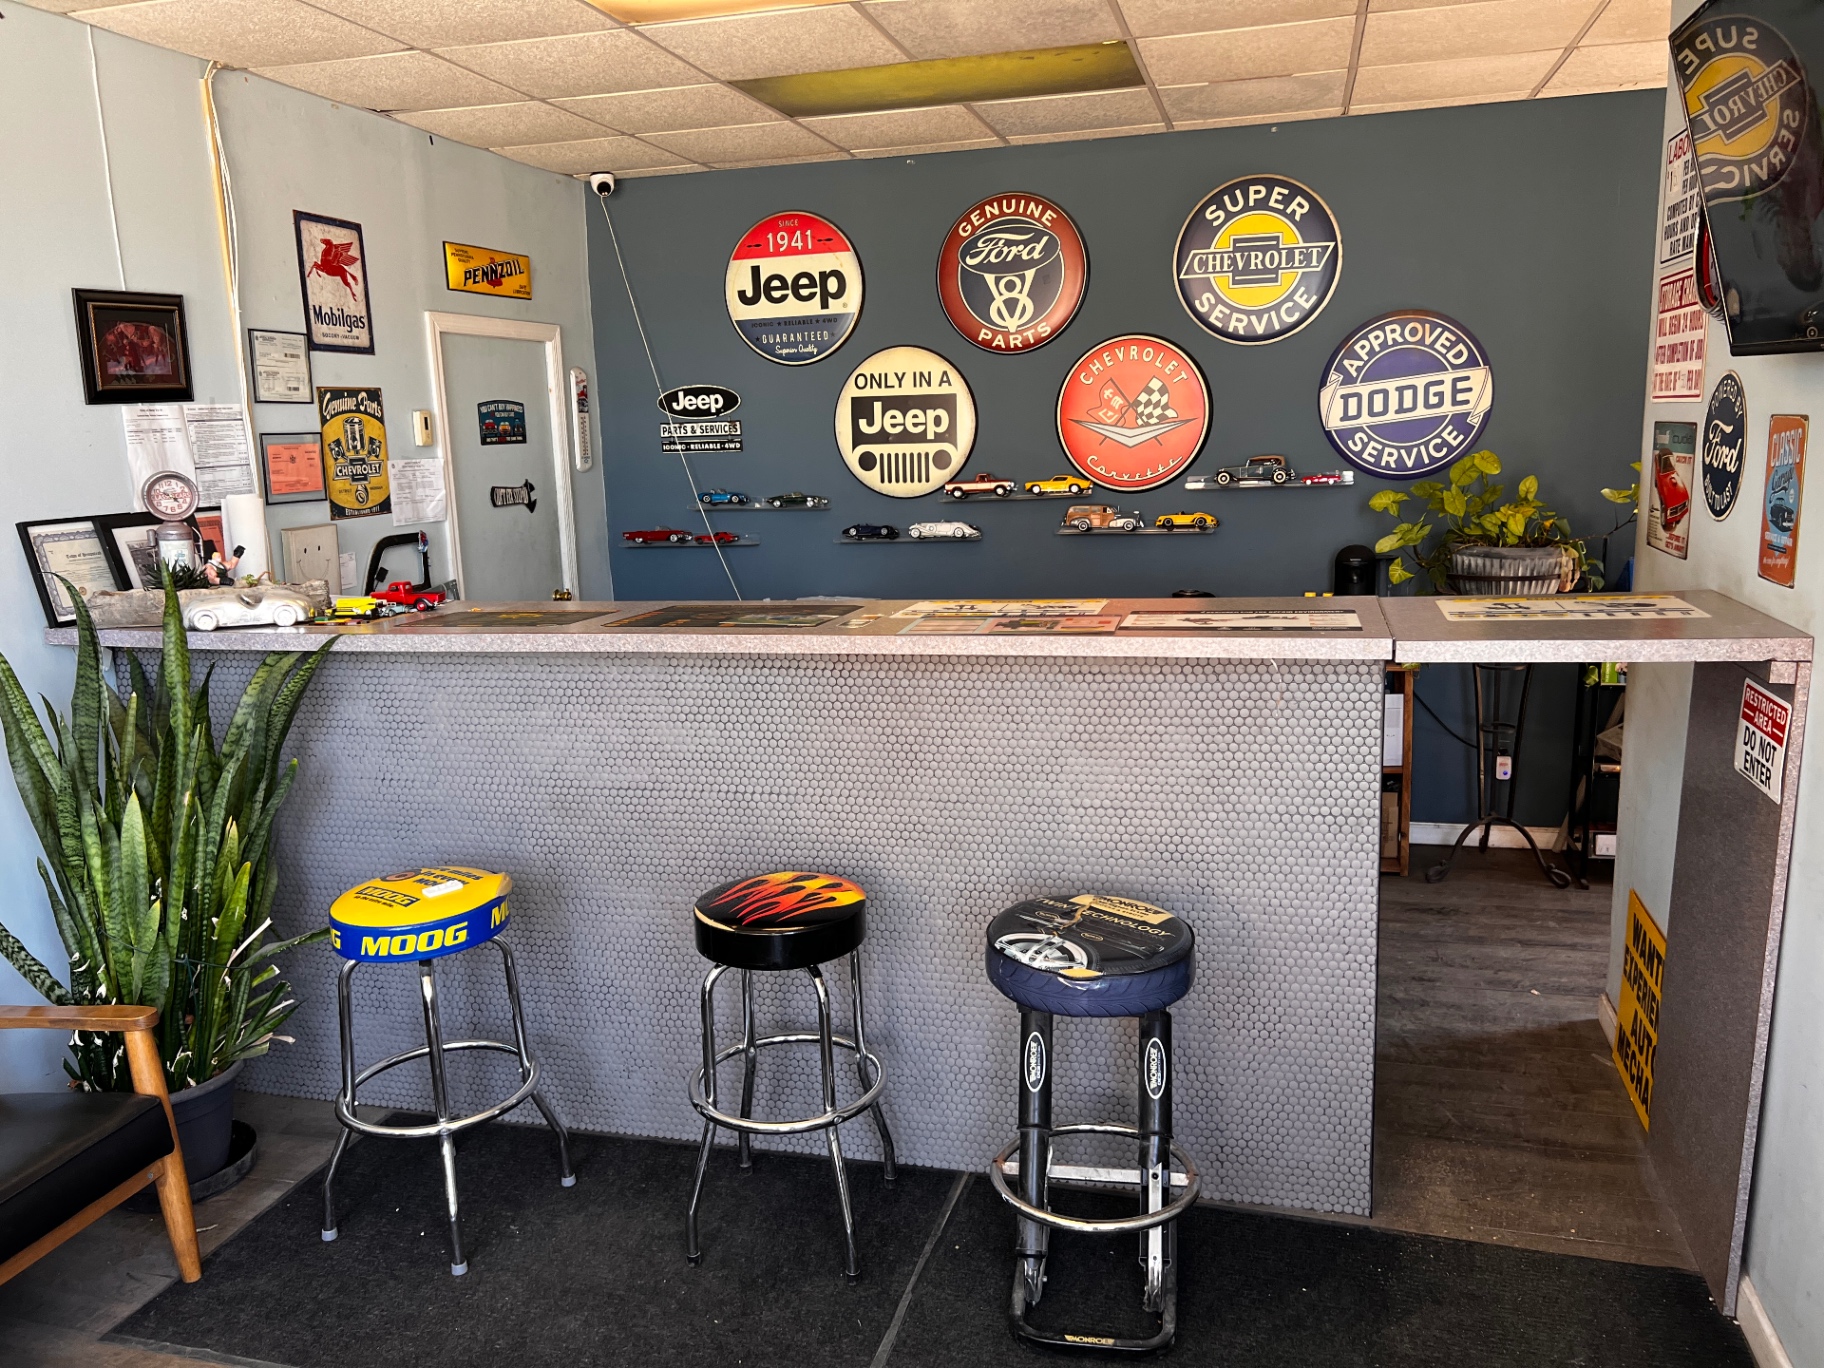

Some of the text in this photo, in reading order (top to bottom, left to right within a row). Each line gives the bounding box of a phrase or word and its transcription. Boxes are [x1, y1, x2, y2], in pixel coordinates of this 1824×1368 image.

[778, 219, 799, 227] SINCE
[958, 199, 1057, 237] GENUINE
[1205, 185, 1310, 227] SUPER
[767, 230, 812, 252] 1941
[965, 232, 1049, 266] Ford
[463, 258, 525, 287] PENNZOIL
[1193, 247, 1322, 273] CHEVROLET
[737, 265, 847, 310] Jeep
[313, 304, 366, 333] Mobilgas
[751, 321, 773, 329] ICONIC
[783, 318, 813, 327] RELIABLE
[1194, 286, 1318, 335] SERVICE
[762, 330, 829, 344] GUARANTEED
[775, 344, 818, 356] Superior Quality
[978, 322, 1051, 349] PARTS
[1342, 322, 1469, 378] APPROVED
[854, 370, 952, 390] ONLY IN A
[1079, 345, 1188, 386] CHEVROLET
[323, 391, 382, 420] Genuine Parts
[672, 391, 724, 413] Jeep
[1339, 375, 1473, 422] DODGE
[1711, 379, 1737, 415] POWERED
[1735, 396, 1743, 418] BY
[662, 424, 738, 435] PARTS & SERVICES
[858, 401, 949, 440] Jeep
[1348, 425, 1465, 468] SERVICE
[1704, 419, 1742, 473] Ford
[1770, 428, 1802, 467] CLASSIC
[336, 464, 380, 476] CHEVROLET
[1086, 455, 1183, 481] Corvette
[1745, 688, 1786, 725] RESTRICTED
[1753, 711, 1772, 734] AREA
[1743, 726, 1777, 767] DO NOT
[1743, 750, 1771, 790] ENTER
[357, 887, 417, 906] MOOG
[361, 922, 468, 956] MOOG
[1633, 913, 1664, 993] WANT
[1623, 943, 1661, 1034] EXPERIEN
[1150, 1047, 1158, 1089] MONROE
[1617, 1022, 1650, 1115] MECHA
